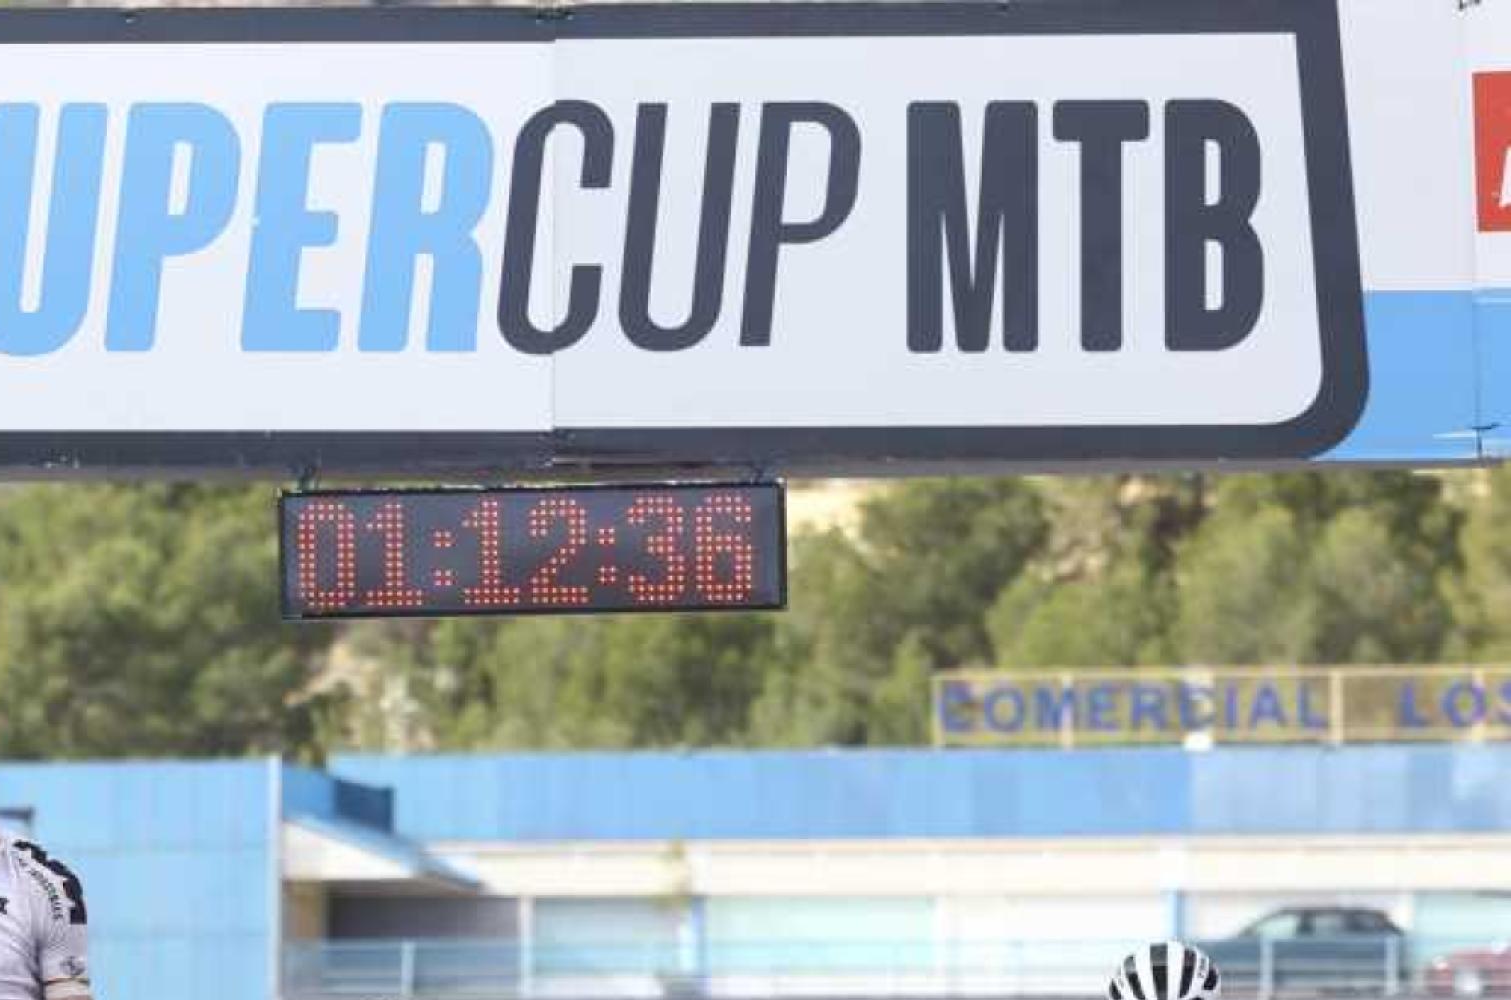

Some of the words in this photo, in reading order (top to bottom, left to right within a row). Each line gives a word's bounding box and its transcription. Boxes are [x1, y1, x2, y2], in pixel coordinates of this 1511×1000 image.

[905, 98, 1264, 354] MTB
[298, 493, 753, 607] 01:12:36
[940, 679, 1330, 733] COMERCIAL
